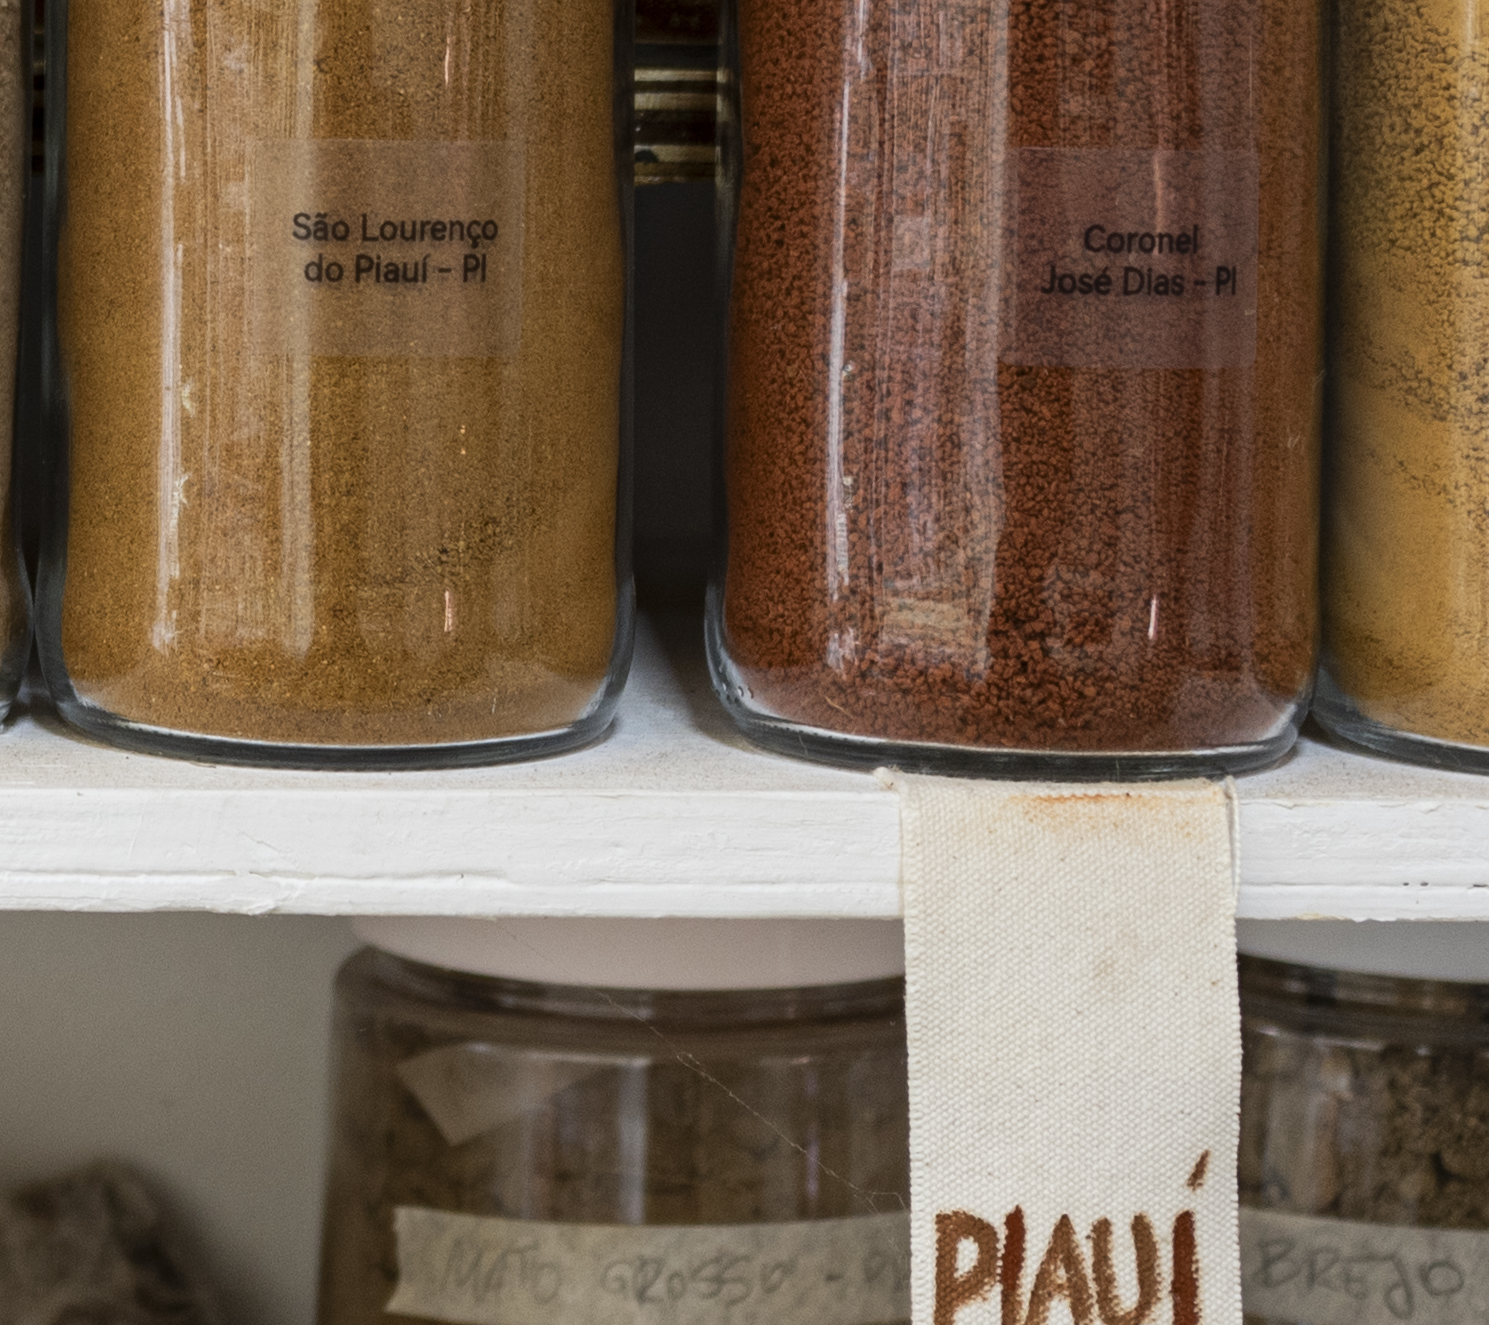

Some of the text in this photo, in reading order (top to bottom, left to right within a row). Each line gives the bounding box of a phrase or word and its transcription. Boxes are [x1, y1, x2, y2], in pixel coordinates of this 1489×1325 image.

[292, 212, 499, 249] São Lourenço
[1083, 224, 1198, 255] Coronel
[304, 253, 344, 283] do
[354, 253, 431, 284] Piauí
[462, 253, 487, 284] PI
[1040, 264, 1113, 296] José
[1122, 265, 1185, 296] Dias
[1215, 265, 1237, 296] PI
